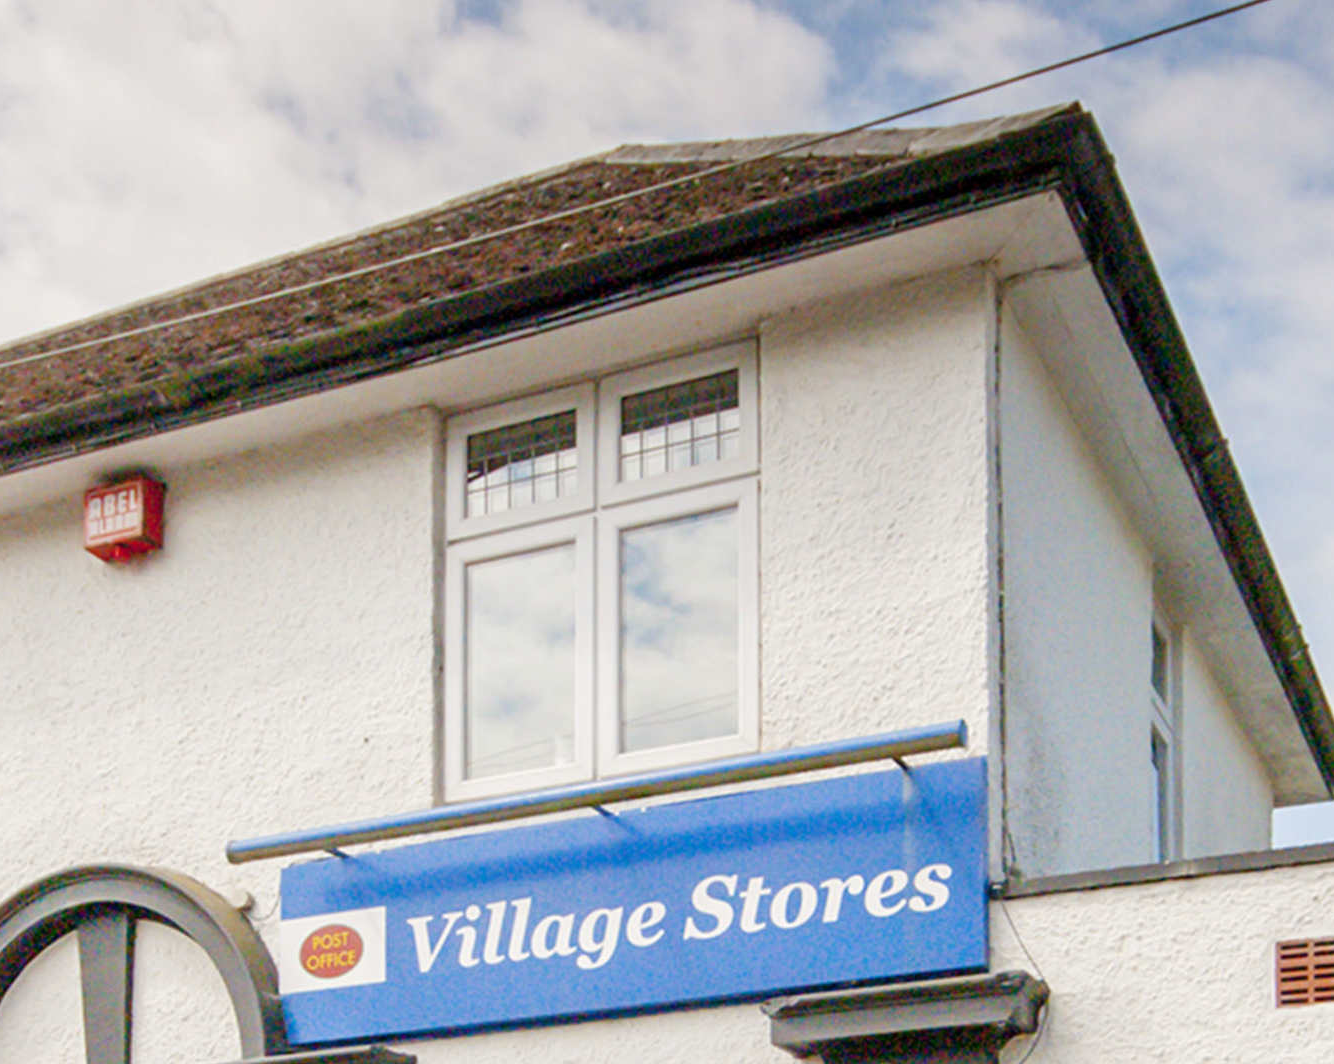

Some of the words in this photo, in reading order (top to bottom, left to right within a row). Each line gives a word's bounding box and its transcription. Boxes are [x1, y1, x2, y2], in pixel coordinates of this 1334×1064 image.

[407, 897, 665, 973] Village
[683, 862, 952, 942] Stores
[312, 931, 350, 951] POST
[306, 949, 356, 971] OFFICE
